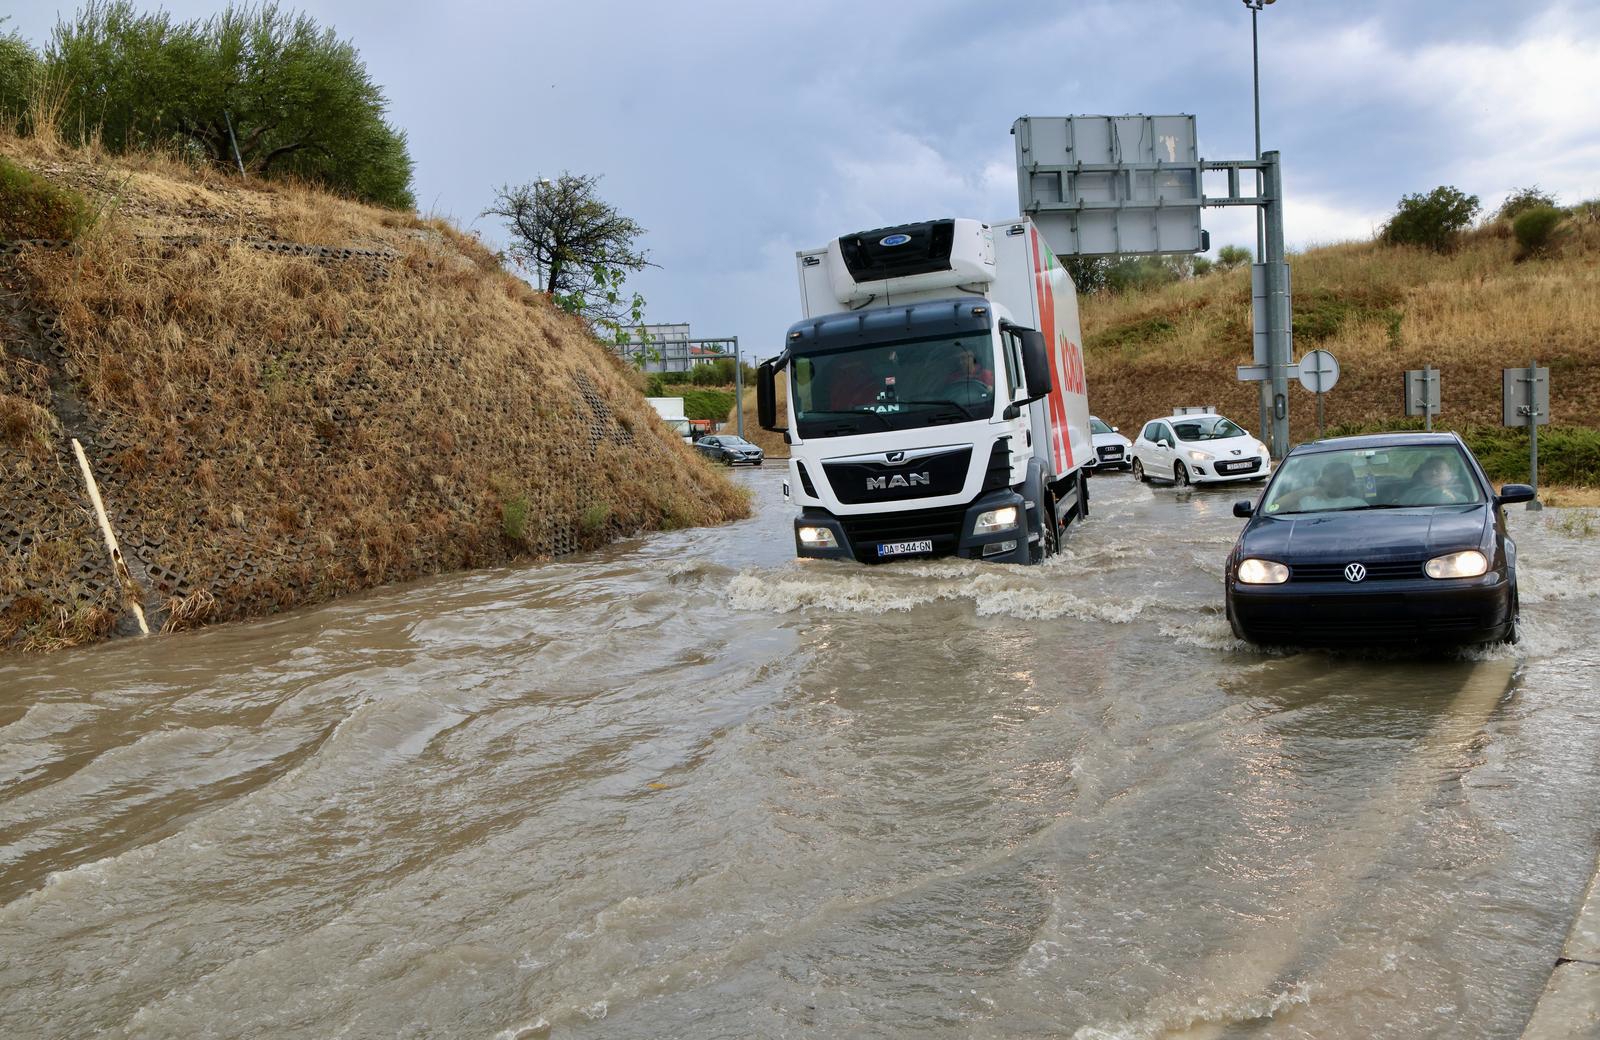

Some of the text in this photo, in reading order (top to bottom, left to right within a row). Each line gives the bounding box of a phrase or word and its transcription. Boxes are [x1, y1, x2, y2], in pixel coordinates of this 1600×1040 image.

[866, 471, 930, 491] MAN
[883, 541, 931, 554] DA 944-GN
